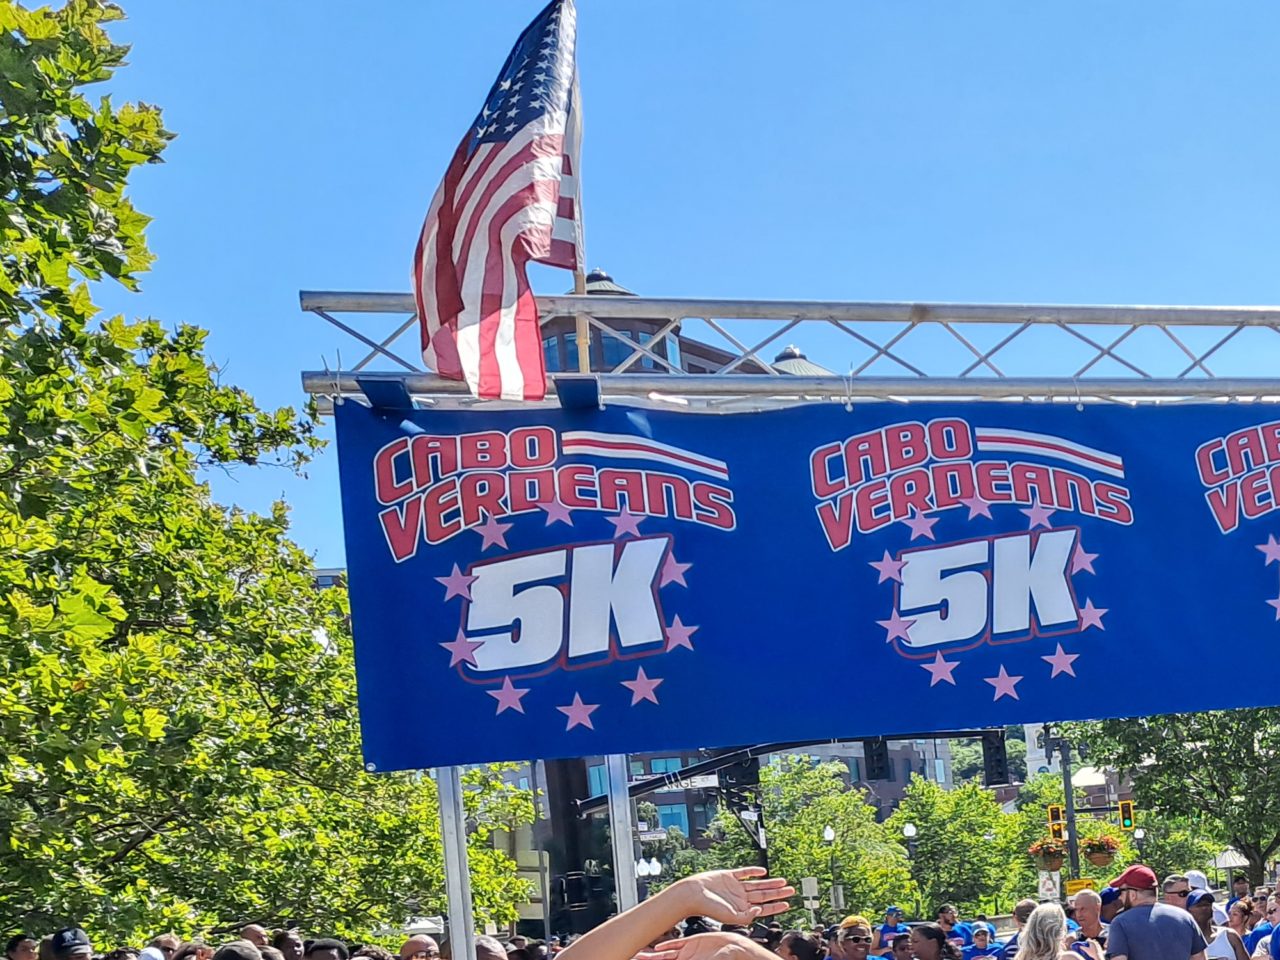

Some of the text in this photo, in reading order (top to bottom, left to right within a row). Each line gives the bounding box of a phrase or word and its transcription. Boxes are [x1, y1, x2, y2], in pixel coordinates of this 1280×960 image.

[374, 426, 557, 504] CABO
[810, 417, 973, 498] CABO
[378, 464, 737, 562] VERDEANS
[815, 460, 1134, 552] VERDEANS
[466, 537, 669, 671] 5K
[900, 529, 1077, 647] 5K
